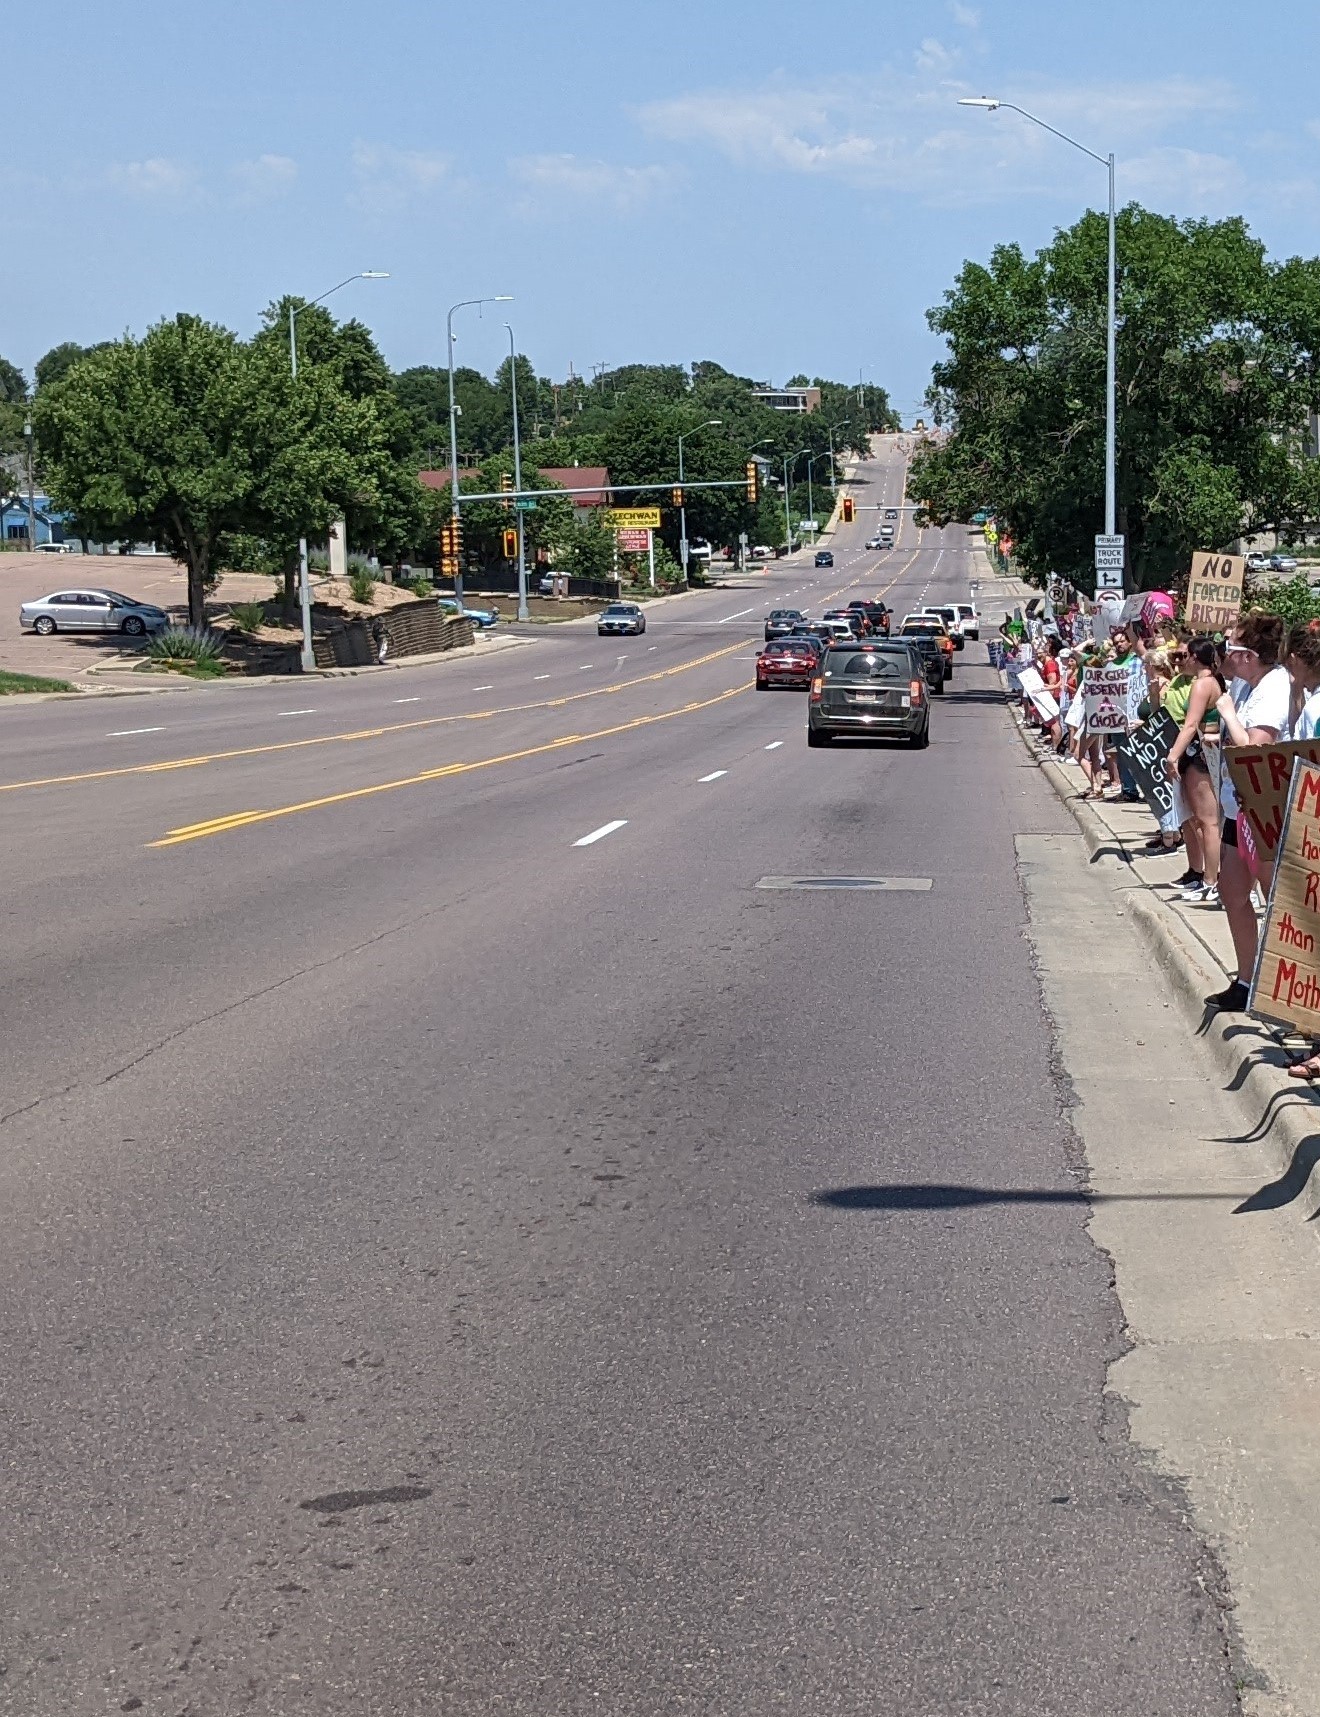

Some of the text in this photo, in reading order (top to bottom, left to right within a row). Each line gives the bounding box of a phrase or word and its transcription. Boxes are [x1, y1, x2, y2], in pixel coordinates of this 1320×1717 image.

[1097, 536, 1122, 544] PRIMARY
[1097, 549, 1122, 557] TRUCK
[1097, 557, 1122, 566] ROUTE
[1201, 555, 1233, 579] NO
[1192, 581, 1241, 603] FORCED
[1190, 603, 1240, 626] BIRTHS
[1085, 669, 1104, 682] OUR
[1083, 682, 1128, 697] DESERVE
[1120, 711, 1170, 757] WE WILL
[1135, 730, 1168, 770] NOT
[1277, 911, 1314, 952] than
